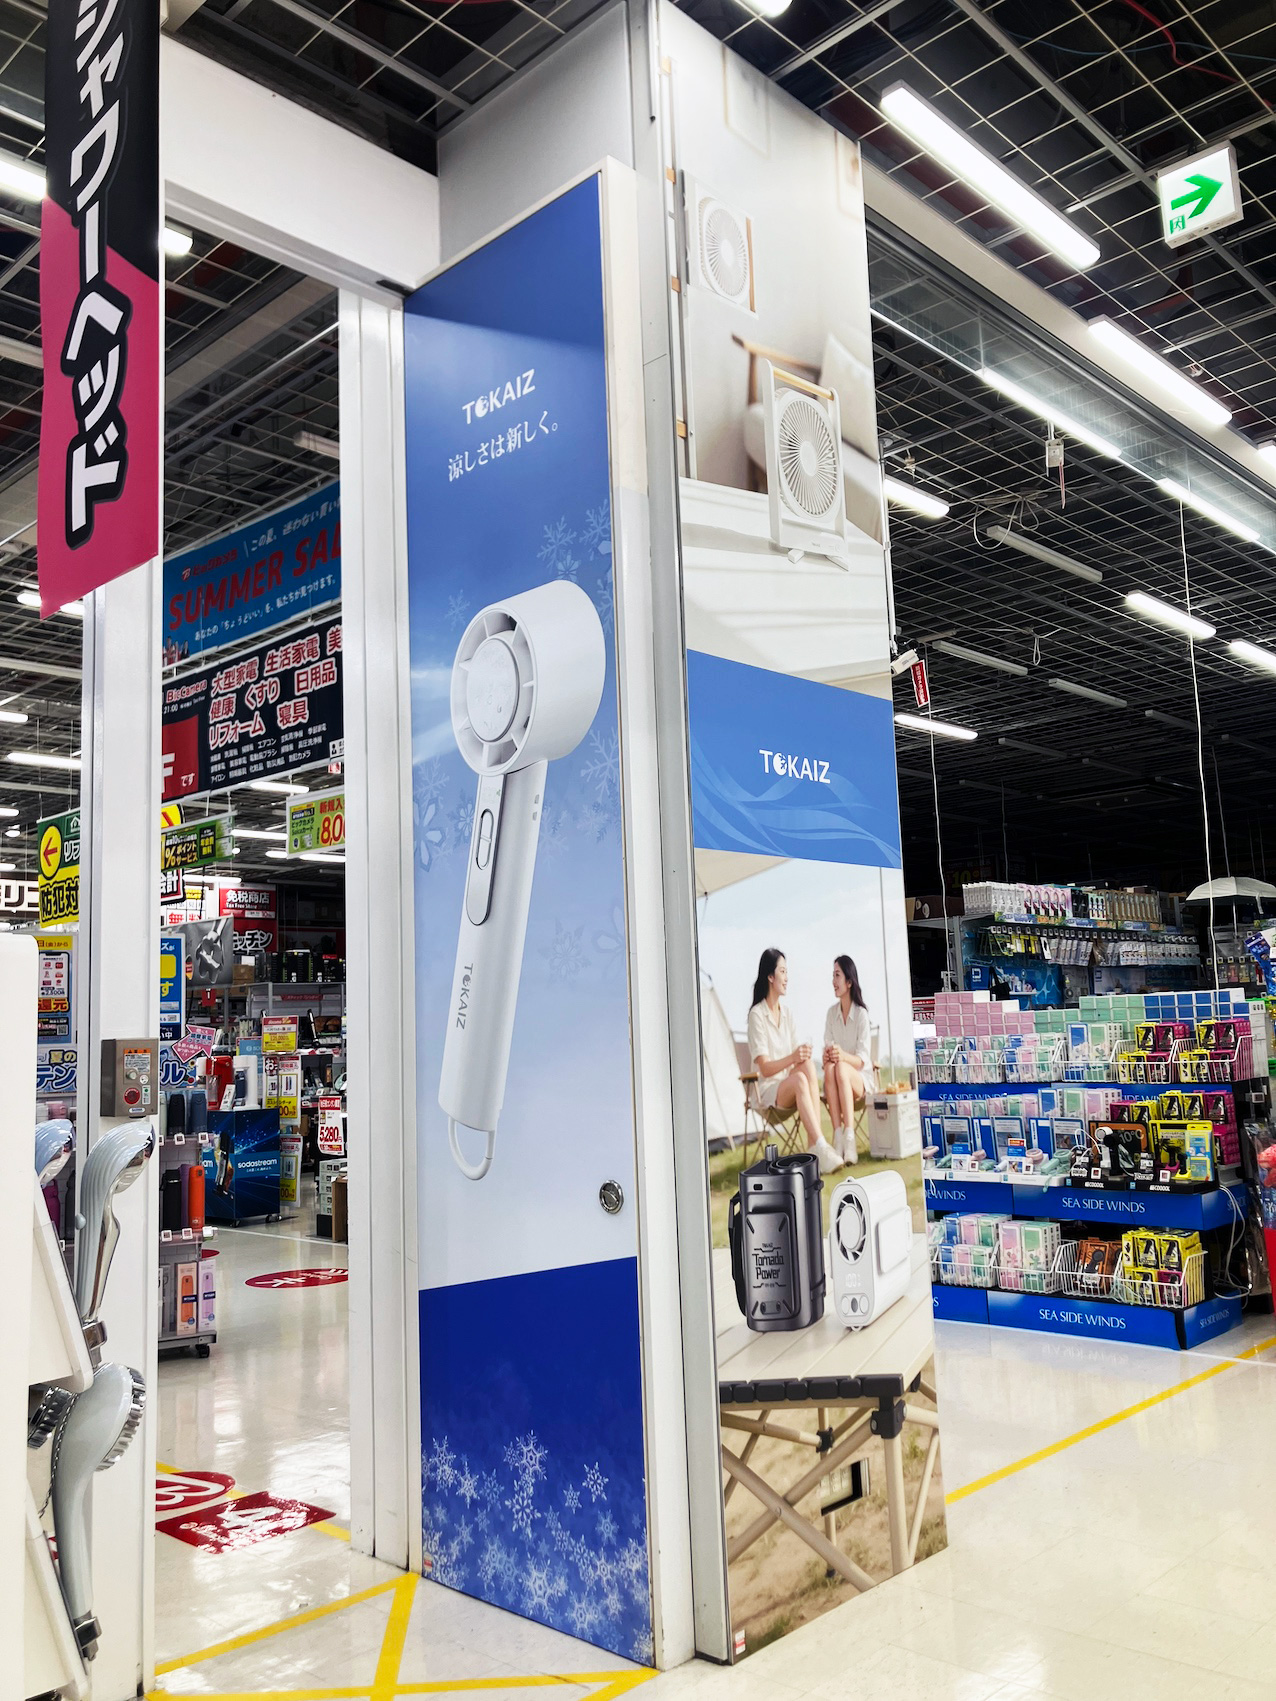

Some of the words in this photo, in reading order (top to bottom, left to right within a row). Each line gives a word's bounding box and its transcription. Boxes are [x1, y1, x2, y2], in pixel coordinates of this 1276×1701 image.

[462, 369, 536, 424] TOKAIZ
[448, 411, 558, 482] 涼しさは新しく。
[169, 550, 285, 631] SUMMER
[211, 658, 259, 696] 大型家電
[264, 633, 320, 676] 生活家電
[166, 680, 207, 703] BicCamera
[210, 693, 237, 723] 健康
[245, 677, 280, 710] くすり
[295, 657, 337, 695] 日用品
[210, 711, 265, 750] リフォーム
[278, 697, 308, 730] 寝具
[257, 737, 276, 749] エアコン
[759, 749, 830, 784] TOKAIZ
[176, 841, 197, 855] ポイント
[176, 852, 198, 865] サービス
[456, 963, 474, 1029] TOKAIZ
[237, 1158, 278, 1169] sodastream
[934, 1190, 966, 1200] WINDS
[1062, 1197, 1081, 1208] SEA
[1083, 1199, 1105, 1210] SIDE
[1106, 1200, 1145, 1213] WINDS
[752, 1251, 784, 1266] Tornado
[755, 1267, 781, 1280] Power
[1039, 1308, 1058, 1320] SEA
[1060, 1310, 1084, 1324] SIDE
[1085, 1313, 1126, 1329] WINDS
